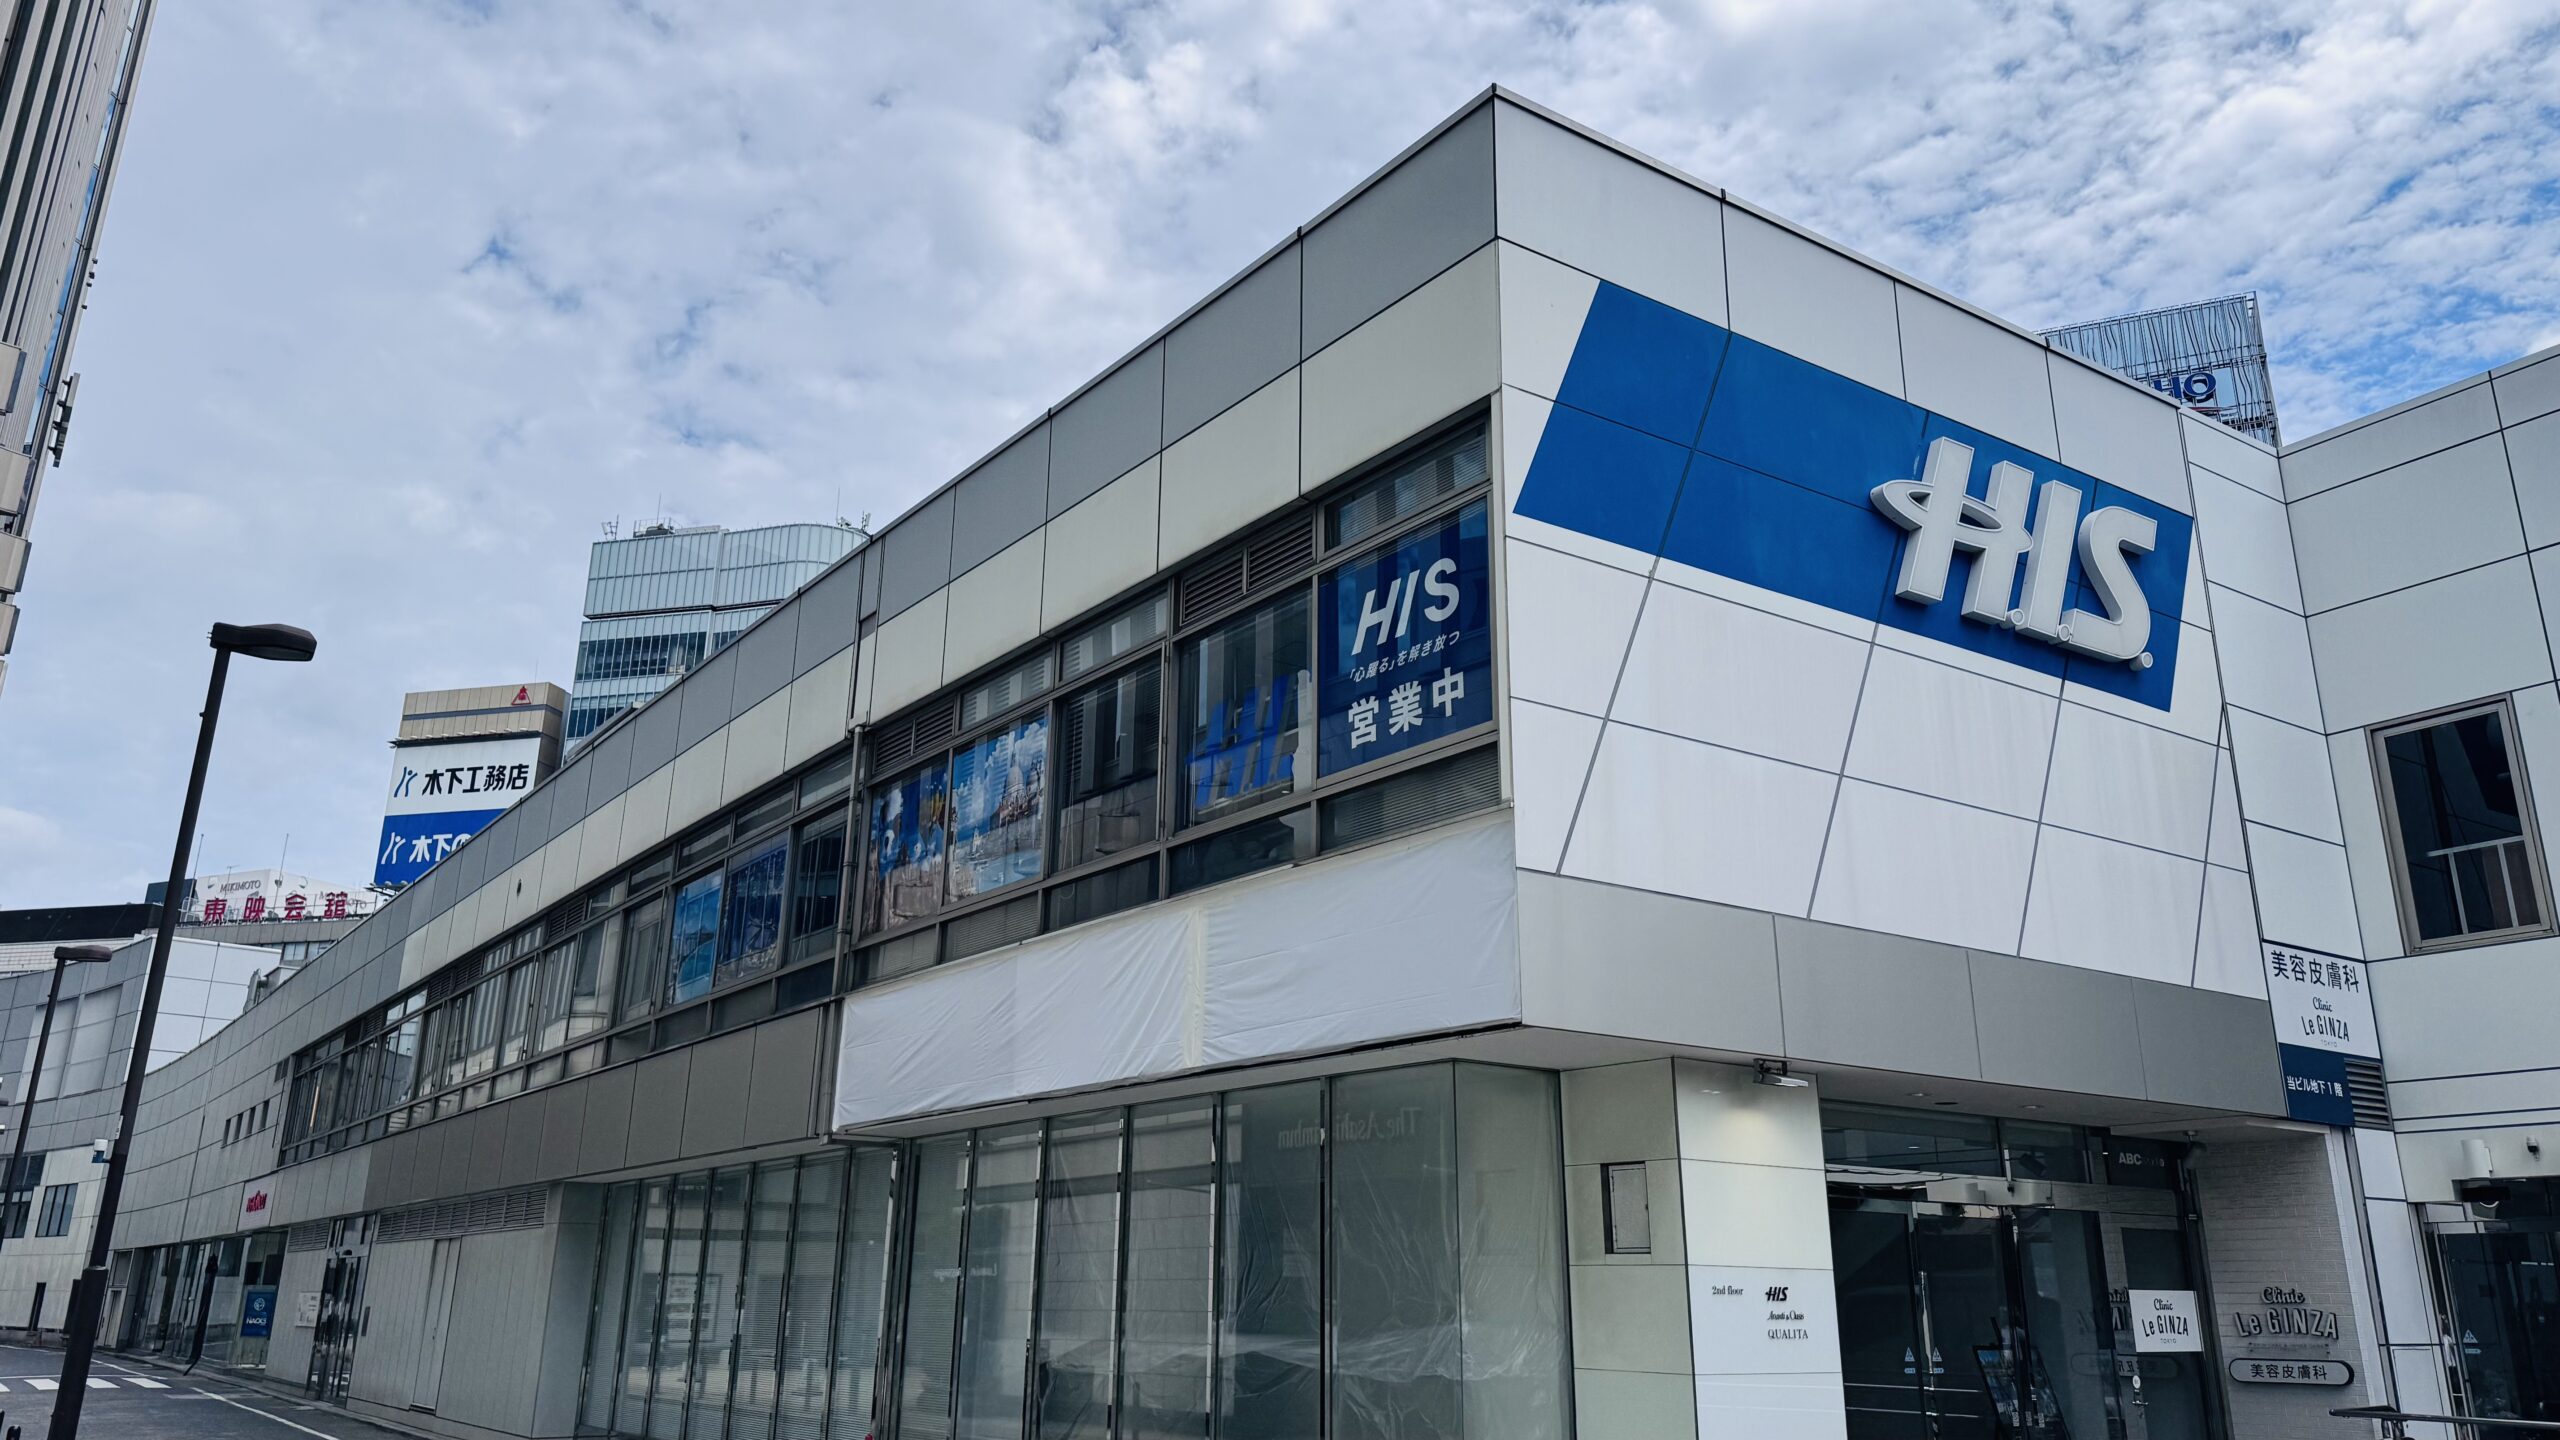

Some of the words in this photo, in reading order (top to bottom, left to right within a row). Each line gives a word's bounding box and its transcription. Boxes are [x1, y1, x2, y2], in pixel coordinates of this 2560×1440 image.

[1352, 557, 1460, 656] HIS
[1349, 667, 1465, 750] 営業中
[422, 763, 530, 796] 木下工務店
[220, 879, 261, 893] MIKIMOTO
[2271, 950, 2360, 993] 美容皮膚科
[2312, 997, 2333, 1012] Clinic
[2301, 1015, 2315, 1036] Le
[2316, 1015, 2350, 1042] GINZA
[1711, 1285, 1726, 1295] 2nd
[1727, 1285, 1744, 1295] floor
[1765, 1286, 1789, 1302] HIS
[2261, 1286, 2305, 1304] Clinic
[2153, 1298, 2174, 1311] Clinic
[2141, 1317, 2155, 1338] Le
[2156, 1314, 2189, 1337] GINZA
[2234, 1312, 2262, 1337] Le
[2266, 1307, 2340, 1340] GINZA
[1767, 1328, 1809, 1340] QUALITA
[2250, 1363, 2328, 1380] 美容皮膚科
